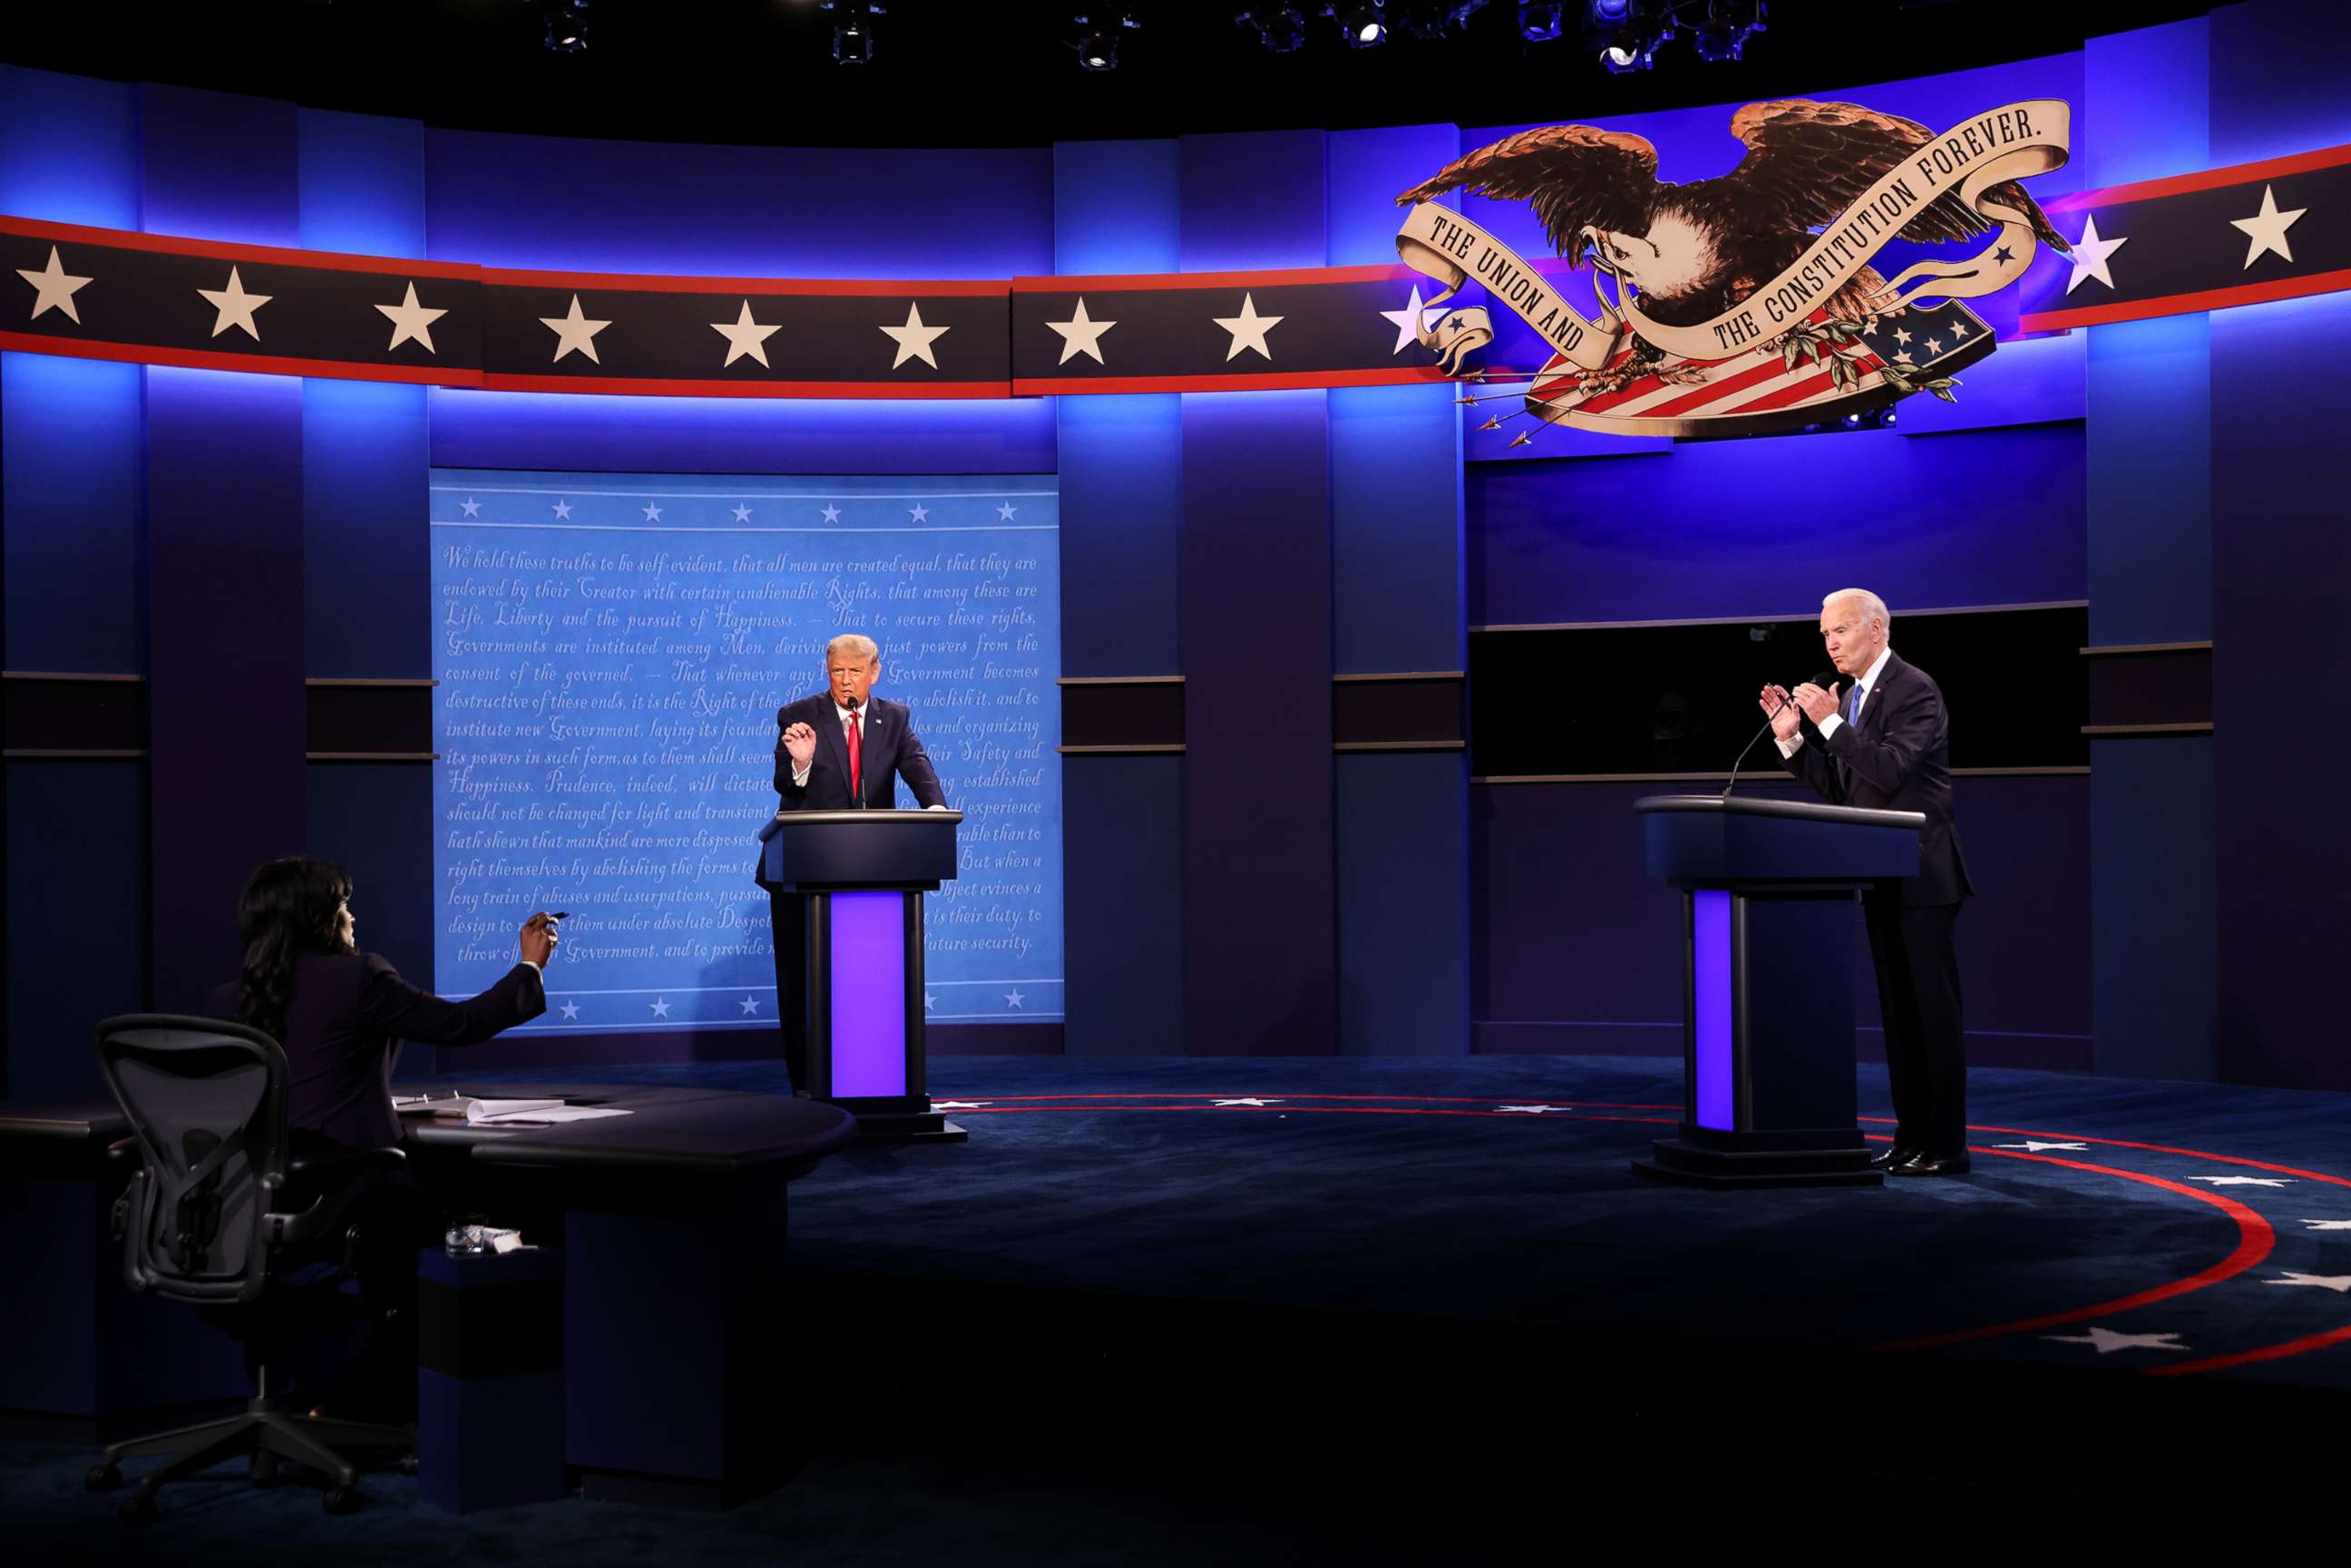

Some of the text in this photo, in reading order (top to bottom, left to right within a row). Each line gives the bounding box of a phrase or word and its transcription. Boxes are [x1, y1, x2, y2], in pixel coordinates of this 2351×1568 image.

[1713, 108, 2042, 351] THE CONSTITUTION FOREVER.
[1429, 214, 1585, 353] THE UNION AND
[444, 545, 471, 569] We
[473, 550, 508, 569] hold
[509, 551, 546, 570] these
[551, 552, 596, 571] truths
[600, 559, 614, 571] to
[619, 553, 634, 571] be
[732, 553, 762, 572] that
[766, 553, 788, 572] all
[789, 561, 817, 572] men
[822, 561, 843, 572] are
[847, 554, 902, 571] created
[946, 553, 975, 571] that
[980, 552, 1010, 579] they
[1015, 558, 1037, 570] are
[444, 578, 508, 597] endowed
[510, 579, 530, 606] by
[535, 579, 571, 598] their
[576, 576, 637, 599] Creator
[643, 581, 678, 599] with
[680, 582, 729, 599] certain
[888, 580, 917, 599] that
[922, 587, 968, 606] among
[973, 580, 1010, 598] these
[1015, 584, 1038, 598] are
[494, 601, 553, 635] Liberty
[562, 608, 592, 626] and
[597, 608, 619, 626] the
[622, 609, 682, 635] pursuit
[690, 609, 709, 635] of
[832, 607, 867, 626] That
[874, 614, 887, 626] to
[895, 615, 941, 626] secure
[948, 608, 983, 626] these
[446, 630, 546, 656] Governments
[554, 643, 577, 654] are
[585, 638, 661, 654] instituted
[666, 642, 711, 662] among
[880, 636, 911, 659] just
[916, 642, 967, 660] powers
[971, 632, 1008, 660] from
[1017, 633, 1039, 652] the
[445, 659, 1039, 689] consent of the That whenever any Government becomes
[445, 690, 528, 708] destructive
[532, 690, 551, 716] of
[551, 690, 587, 708] these
[632, 692, 643, 708] it
[647, 692, 660, 708] is
[664, 691, 686, 708] the
[690, 685, 737, 716] Right
[740, 690, 758, 716] of
[758, 691, 780, 708] the
[907, 693, 920, 707] to
[923, 687, 974, 706] abolish
[997, 687, 1026, 706] and
[1026, 692, 1039, 705] to
[446, 718, 511, 737] institute
[515, 725, 544, 736] new
[649, 718, 695, 746] laying
[698, 721, 717, 736] its
[936, 716, 965, 734] and
[964, 716, 1039, 741] organizing
[446, 748, 465, 764] its
[470, 752, 520, 771] powers
[525, 748, 540, 764] in
[544, 746, 581, 764] such
[620, 754, 638, 764] as
[643, 752, 656, 764] to
[661, 746, 695, 764] them
[699, 745, 737, 764] shall
[738, 754, 773, 764] seem
[958, 739, 1010, 768] Safety
[1015, 740, 1044, 760] and
[688, 772, 718, 792] will
[724, 774, 773, 792] dictate
[963, 767, 1044, 787] established
[447, 801, 500, 820] should
[501, 806, 523, 820] not
[529, 803, 545, 820] be
[548, 802, 610, 828] changed
[607, 801, 632, 828] for
[635, 801, 671, 827] light
[675, 802, 706, 820] and
[706, 803, 771, 820] transient
[967, 798, 1041, 822] experience
[447, 823, 1041, 854] hath shewn that mankind are more disposed than to
[447, 845, 1029, 886] right themselves by abolishing the forms to But when
[448, 884, 479, 912] long
[483, 886, 519, 904] train
[522, 884, 542, 912] of
[541, 884, 590, 904] abuses
[593, 884, 624, 904] and
[980, 880, 1030, 896] evinces
[448, 916, 496, 940] design
[500, 920, 515, 932] to
[571, 913, 604, 930] them
[607, 911, 649, 930] under
[653, 911, 713, 930] absolute
[949, 905, 982, 923] their
[1028, 911, 1041, 922] to
[457, 943, 502, 962] throw
[664, 939, 696, 957] and
[695, 944, 707, 956] to
[707, 938, 765, 964] provide
